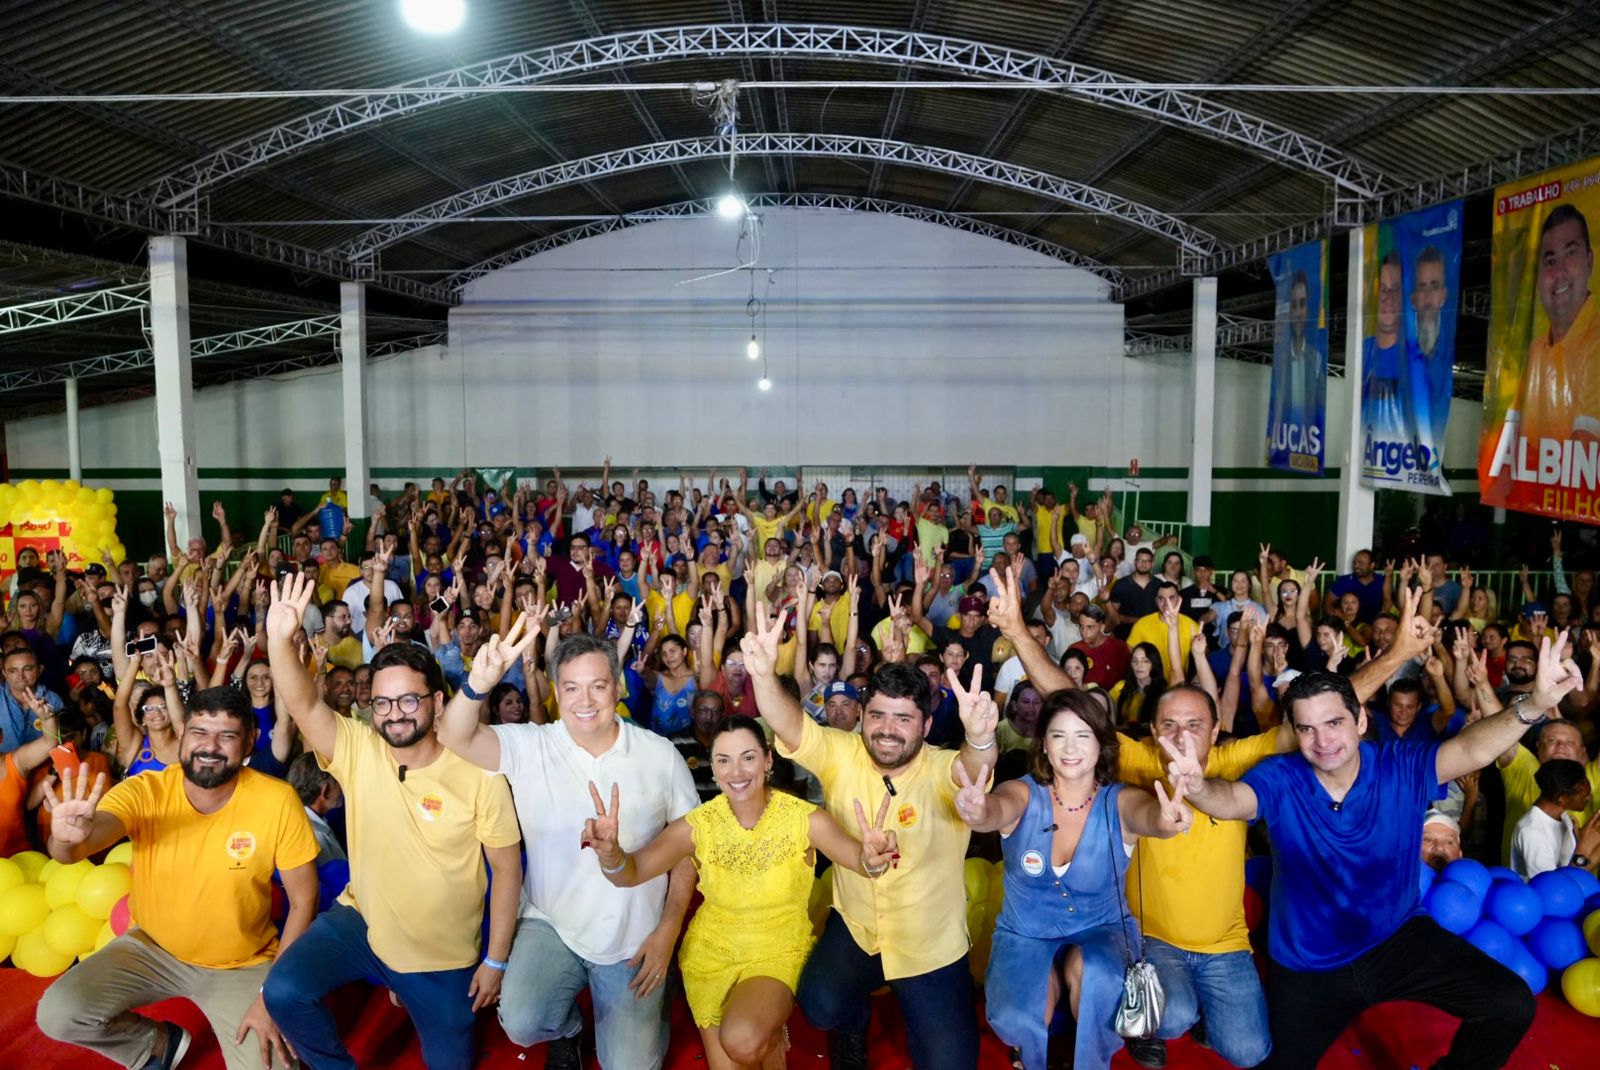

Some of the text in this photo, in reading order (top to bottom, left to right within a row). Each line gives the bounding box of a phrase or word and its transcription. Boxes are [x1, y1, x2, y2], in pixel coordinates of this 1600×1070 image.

[1499, 200, 1506, 213] O
[1508, 183, 1560, 210] TRABALHO
[1271, 422, 1321, 455] LUCAS
[1488, 409, 1600, 491] ALBIN
